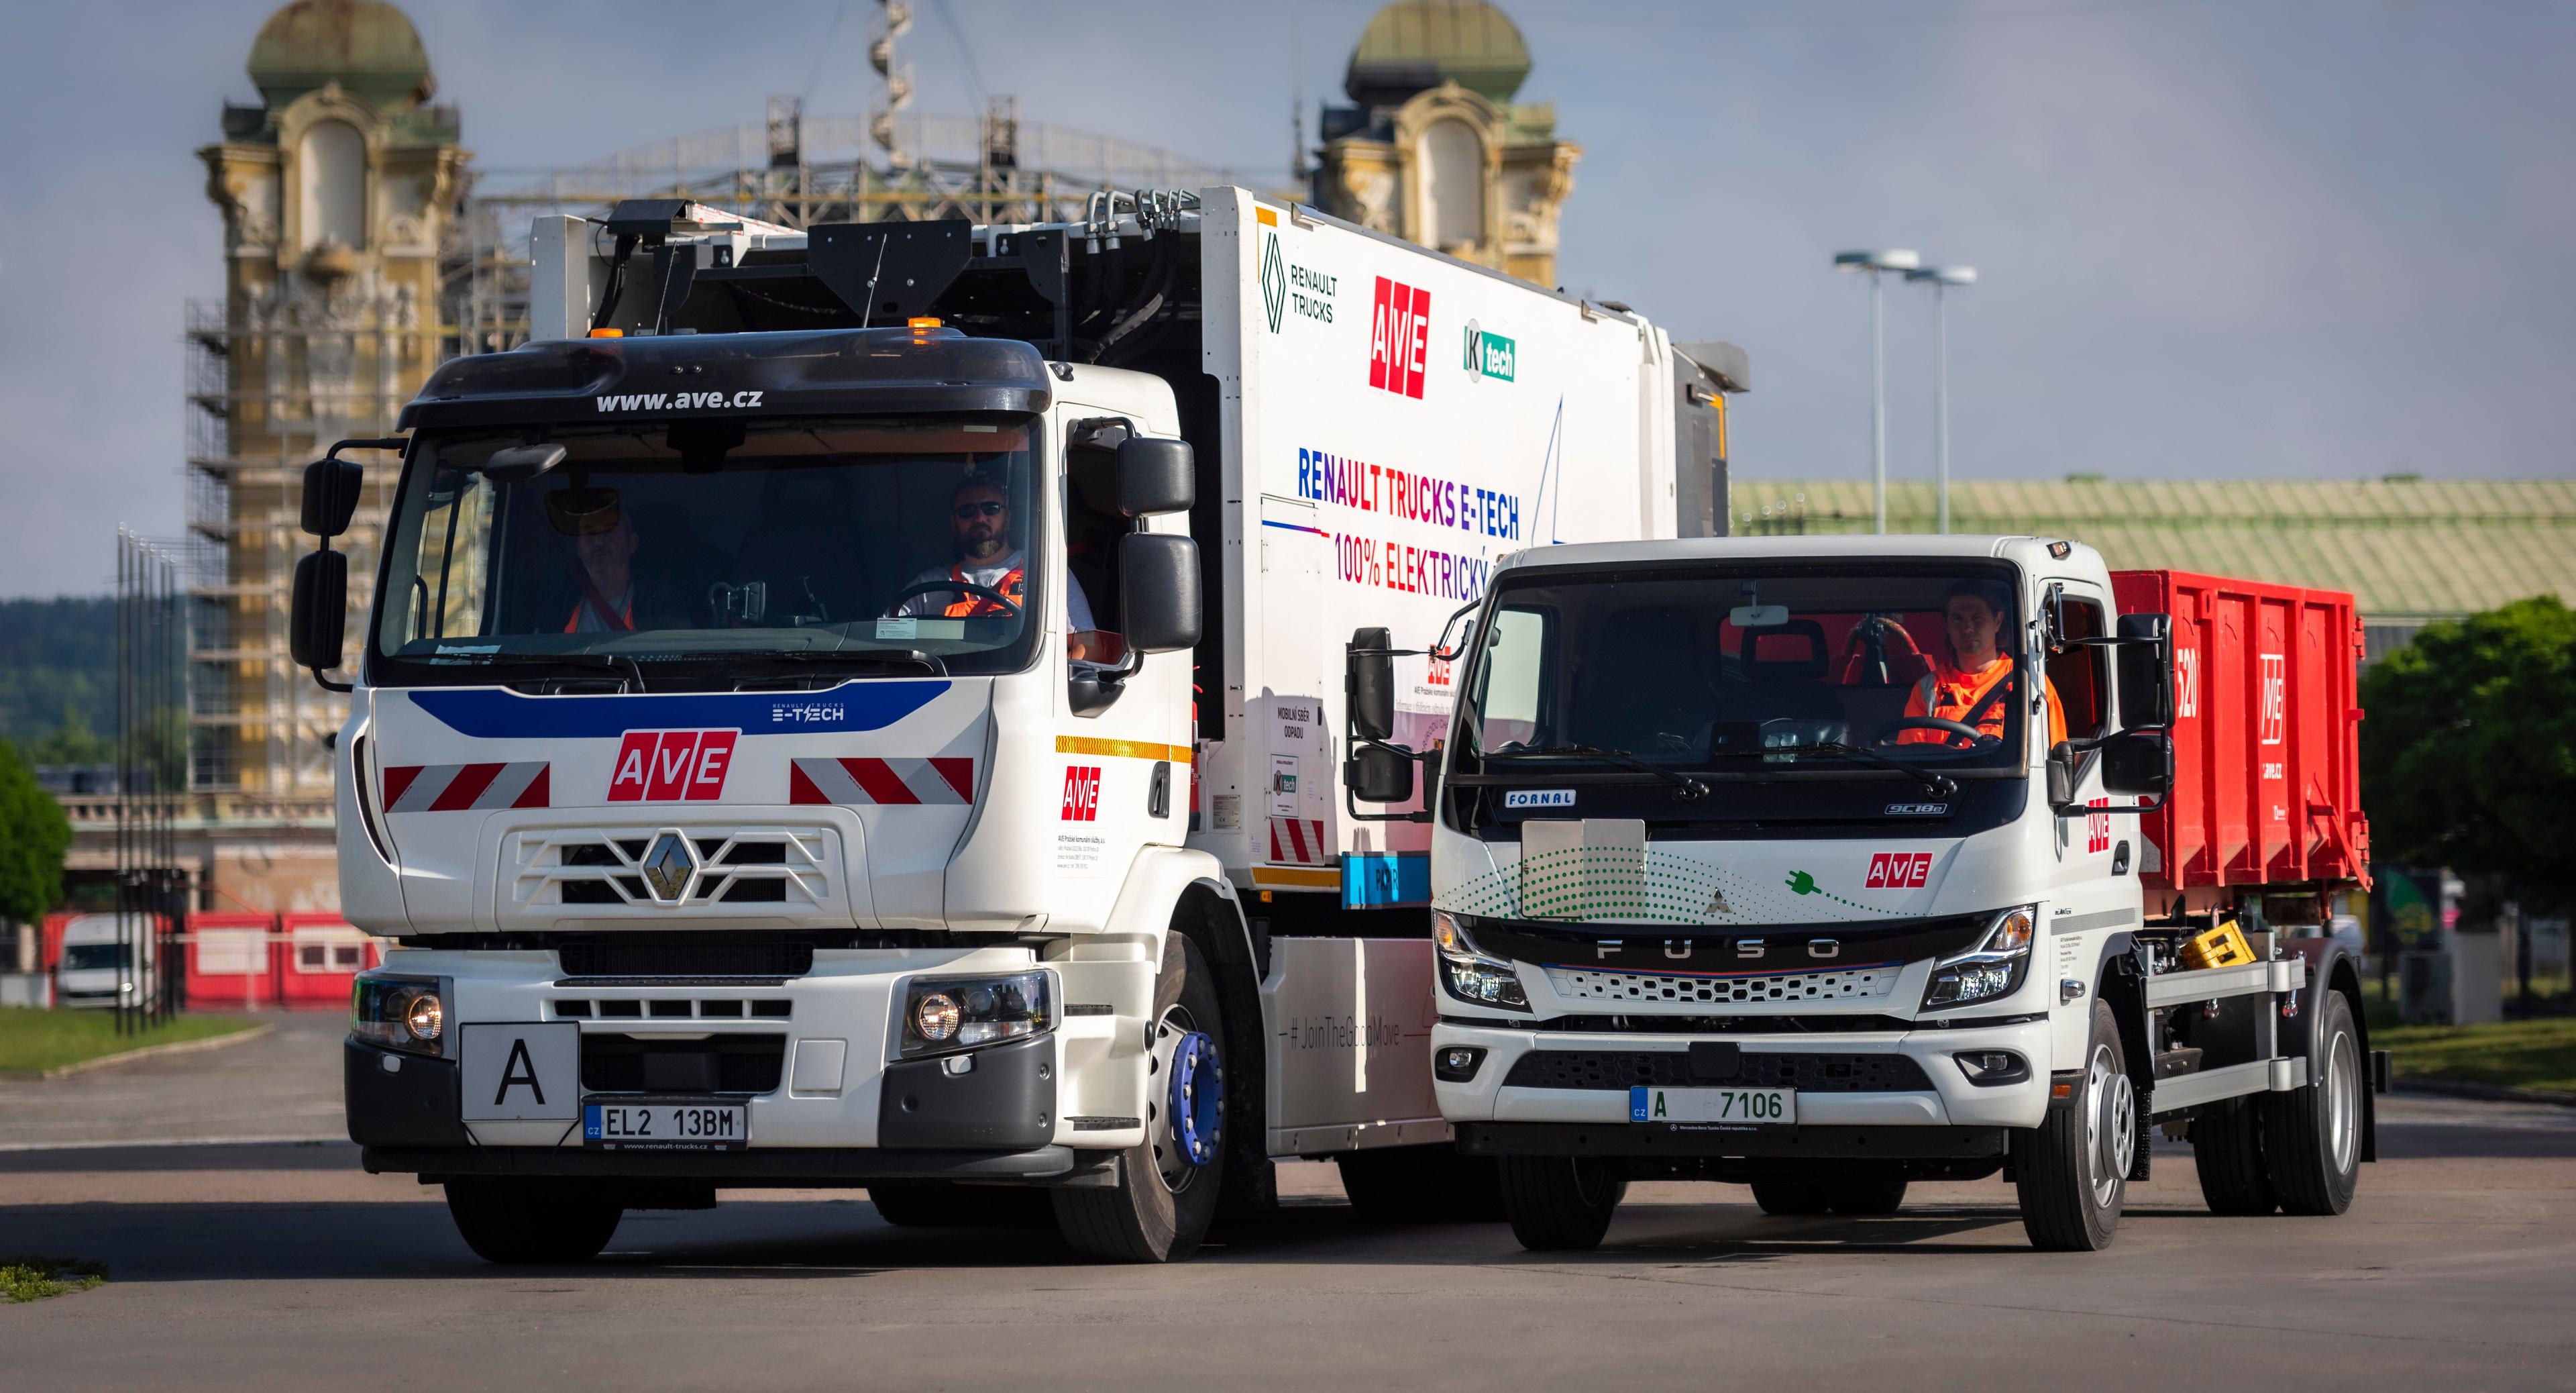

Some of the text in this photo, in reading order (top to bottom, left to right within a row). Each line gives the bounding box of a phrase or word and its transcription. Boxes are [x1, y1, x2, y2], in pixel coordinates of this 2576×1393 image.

[1291, 264, 1337, 297] RENAULT
[1292, 293, 1333, 323] TRUCKS
[1372, 303, 1427, 373] AVE
[1486, 342, 1513, 378] tech
[596, 391, 763, 413] www.ave.cz
[1299, 448, 1519, 541] RENAULT TRUCKS E-TECH
[1335, 533, 1488, 602] 100% ELEKTRICKÝ
[773, 708, 844, 722] E-TECH
[1278, 706, 1297, 721] MOBILNÍ
[1284, 725, 1303, 739] ODPADU
[614, 747, 729, 785] AVE
[1063, 779, 1099, 809] AVE
[1509, 793, 1571, 805] FORNAL
[1376, 862, 1399, 891] PAPÍR
[1869, 861, 1929, 880] AVE
[1597, 939, 1839, 960] FUSO
[1301, 1015, 1399, 1049] JoinTheGoodMove
[494, 1039, 546, 1106] A
[1634, 1091, 1782, 1119] CZ A 7106
[588, 1109, 733, 1137] CZ EL2 13BM
[623, 1143, 708, 1151] www.renault-trucks.cz
